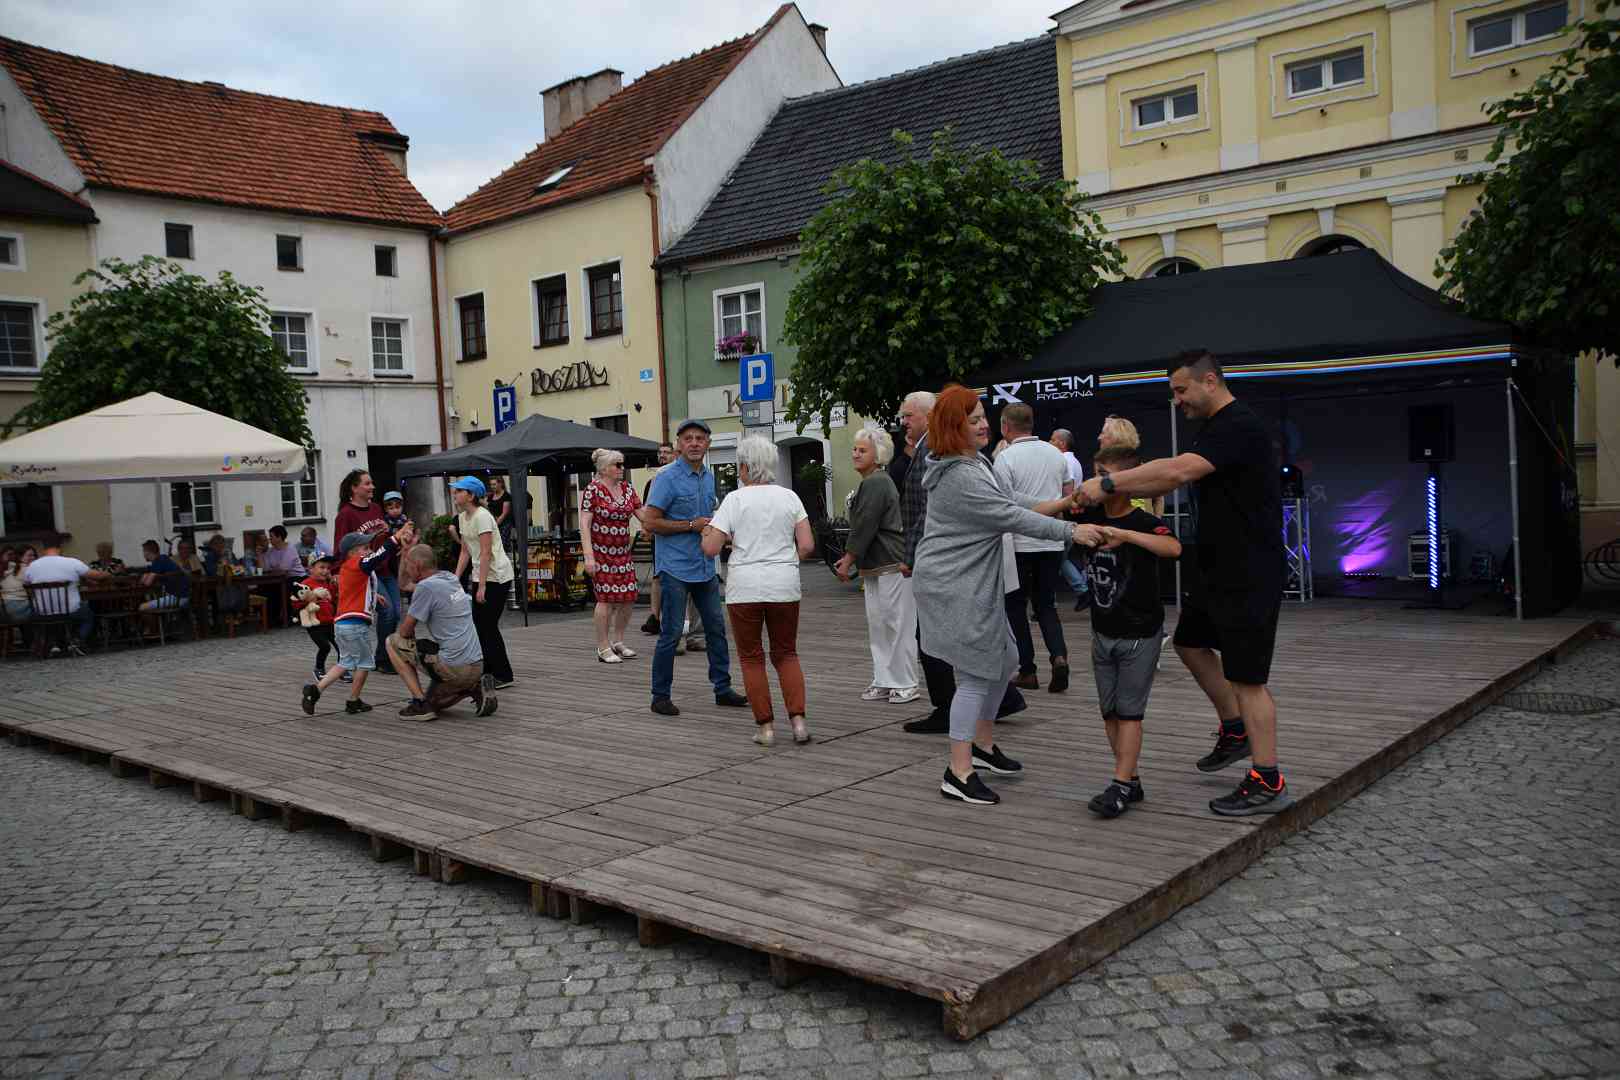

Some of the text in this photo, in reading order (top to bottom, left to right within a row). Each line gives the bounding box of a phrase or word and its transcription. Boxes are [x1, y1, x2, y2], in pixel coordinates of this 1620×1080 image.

[530, 360, 609, 396] POCZTA
[748, 360, 767, 396] P
[498, 391, 511, 422] P
[1036, 389, 1094, 401] RYDZYNA
